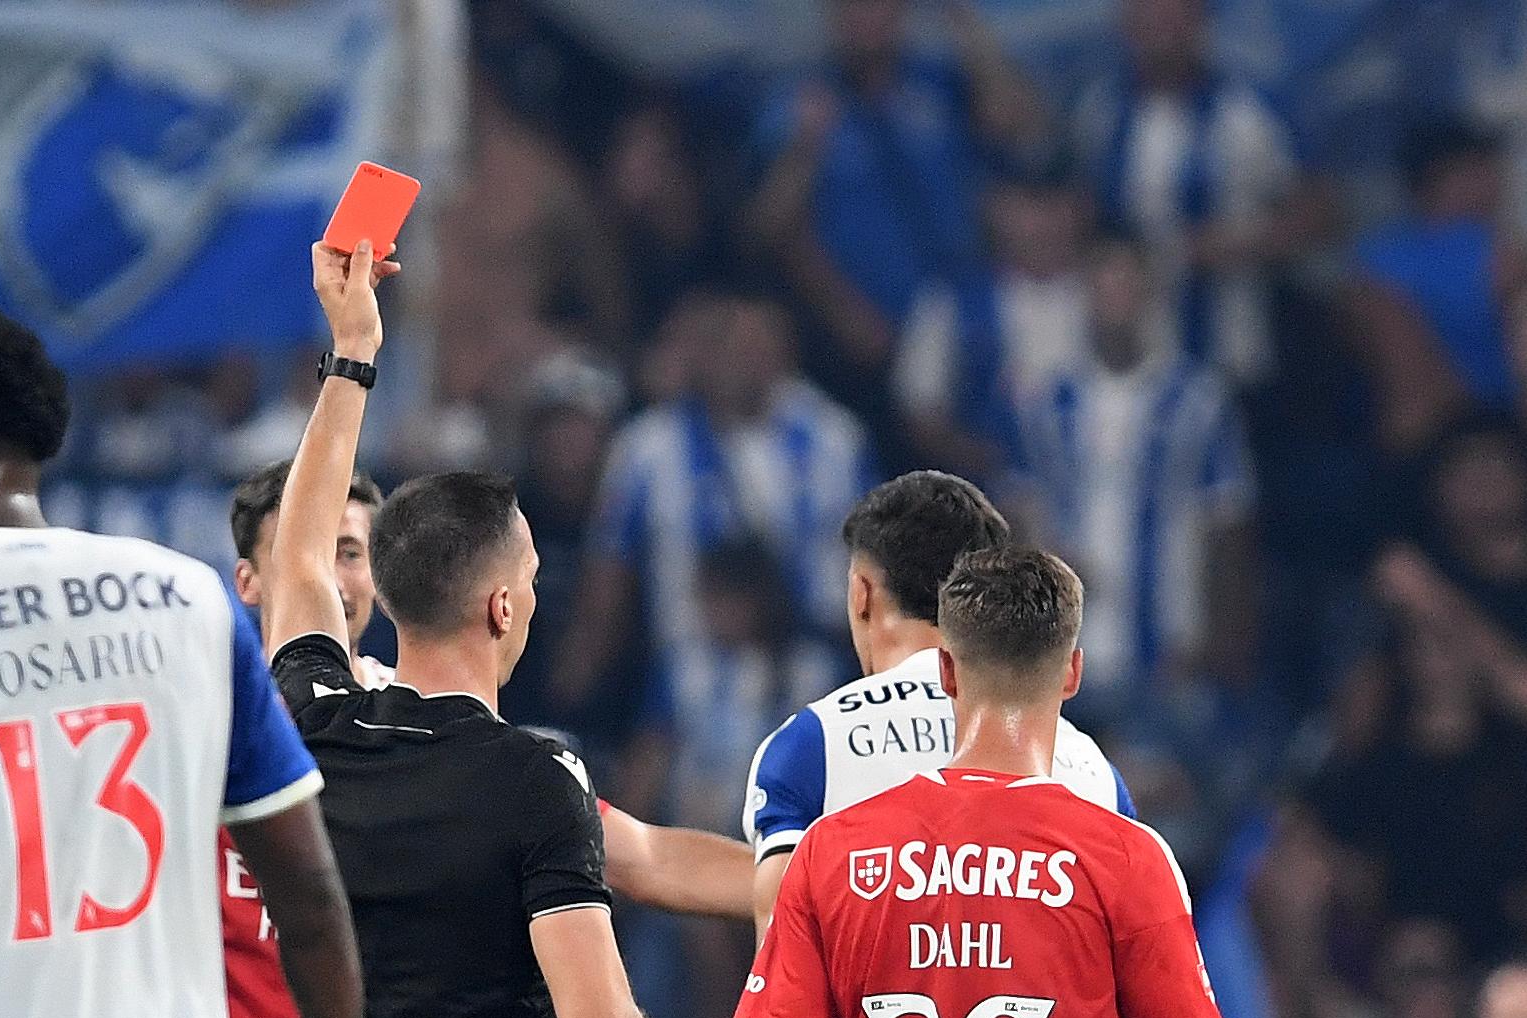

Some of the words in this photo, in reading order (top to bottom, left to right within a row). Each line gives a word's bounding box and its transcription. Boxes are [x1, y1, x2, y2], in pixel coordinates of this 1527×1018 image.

[60, 571, 191, 619] BOCK
[894, 840, 1078, 908] SAGRES
[909, 922, 1013, 970] DAHL
